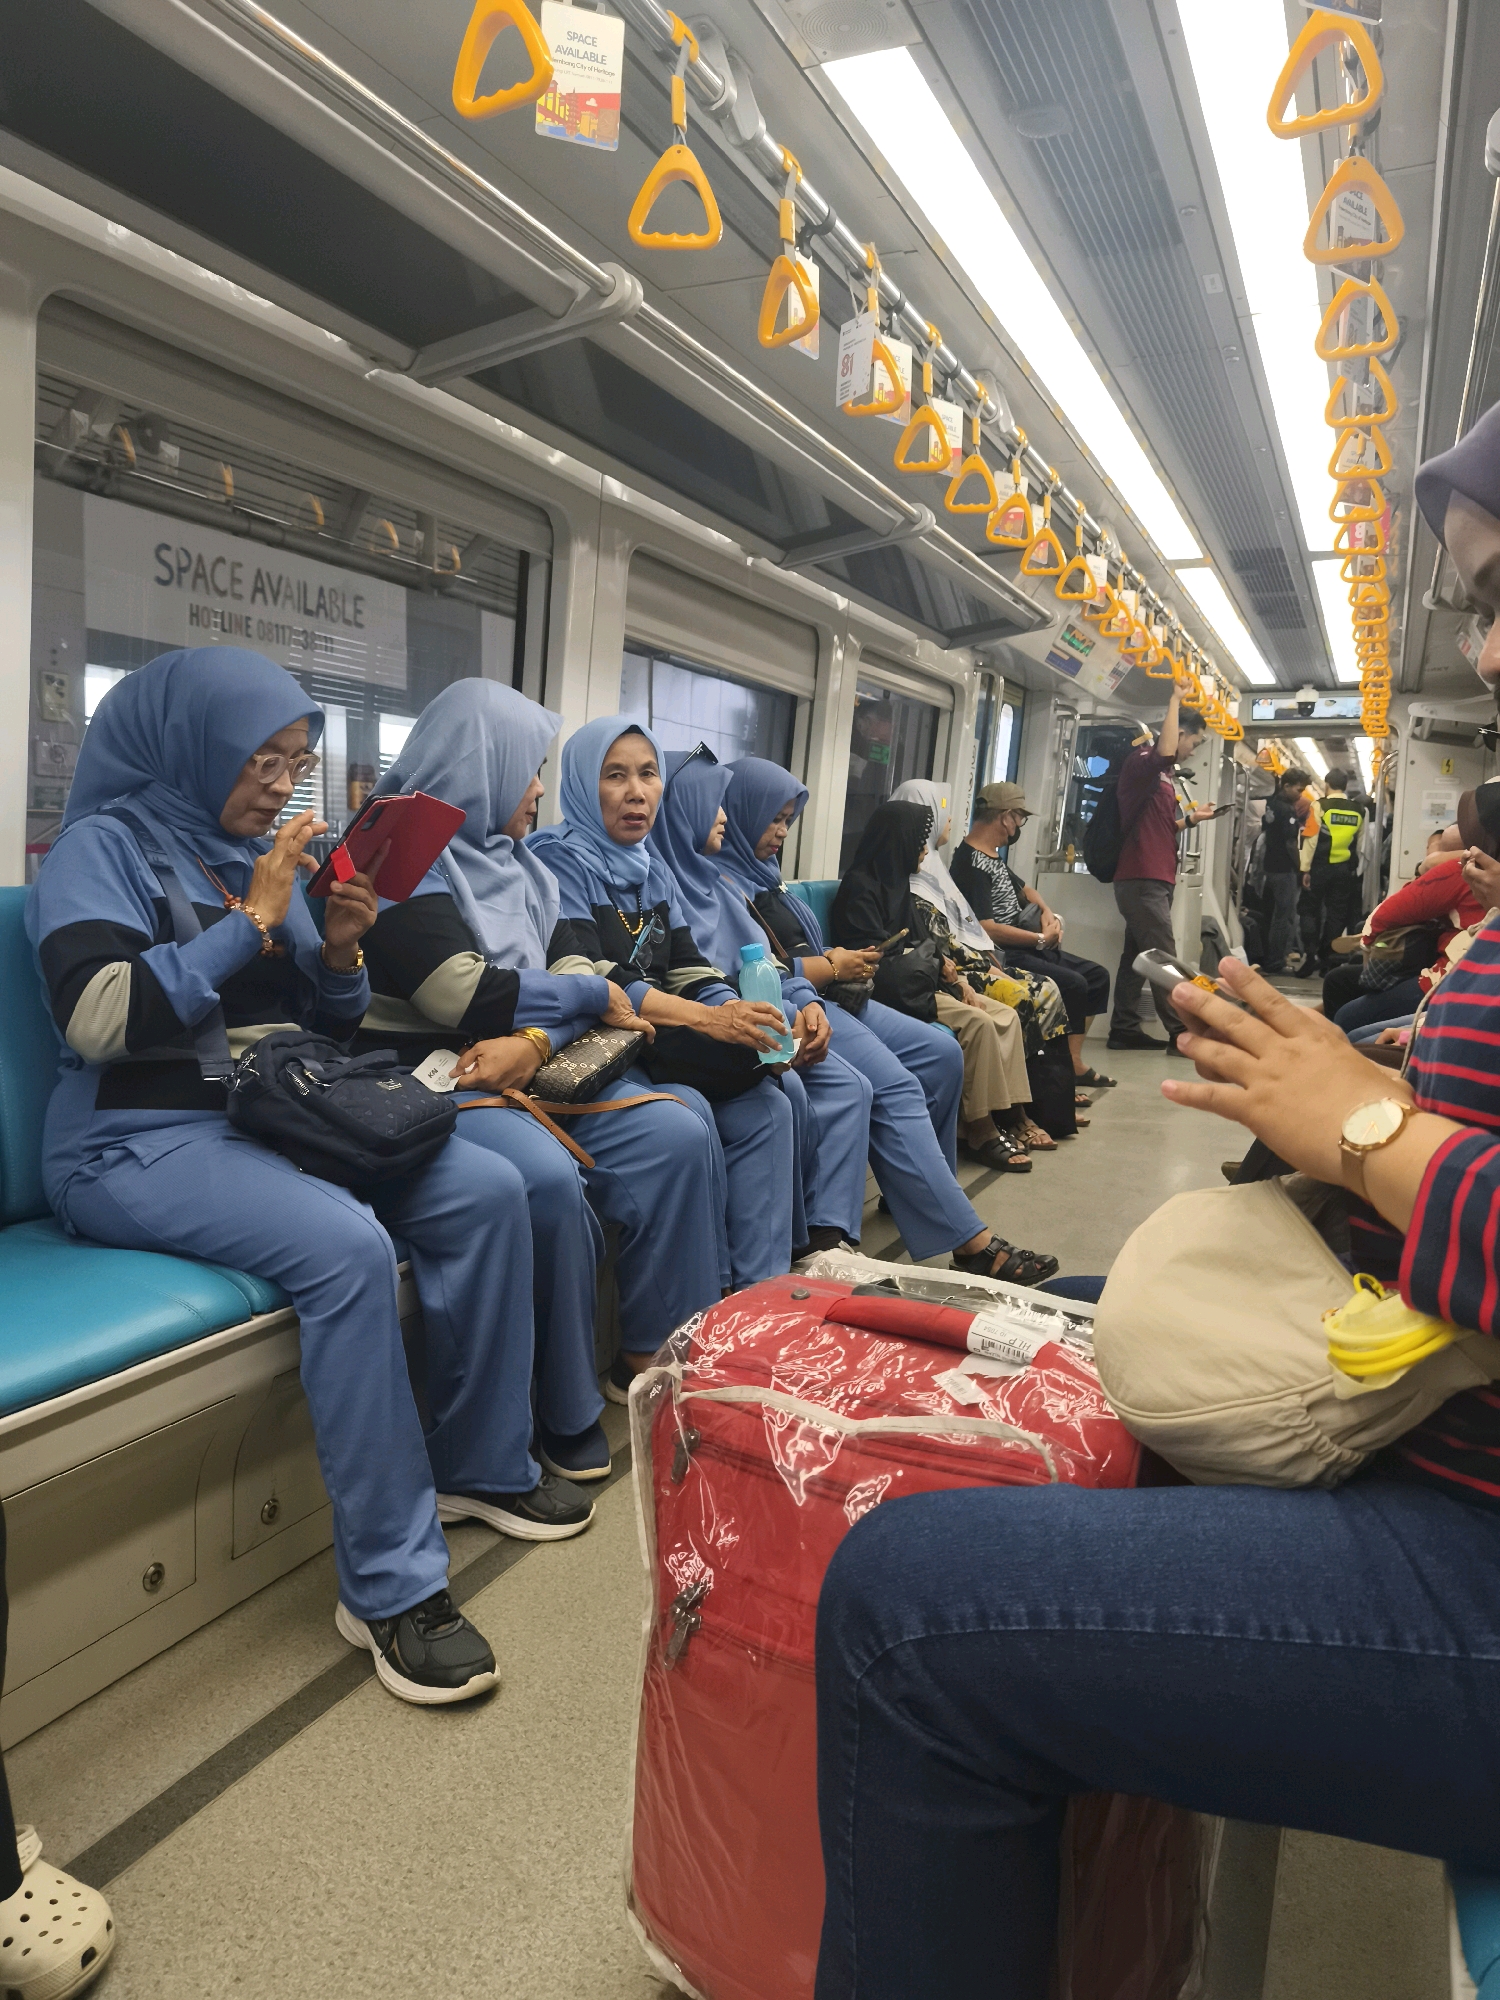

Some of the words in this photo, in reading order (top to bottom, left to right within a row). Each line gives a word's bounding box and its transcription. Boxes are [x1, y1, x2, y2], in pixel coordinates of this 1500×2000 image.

[566, 30, 598, 48] SPACE
[554, 44, 608, 66] AVAILABLE
[576, 62, 587, 72] City
[153, 542, 245, 601] SPACE
[250, 567, 366, 629] AVAILABLE
[188, 603, 253, 639] HOTLINE
